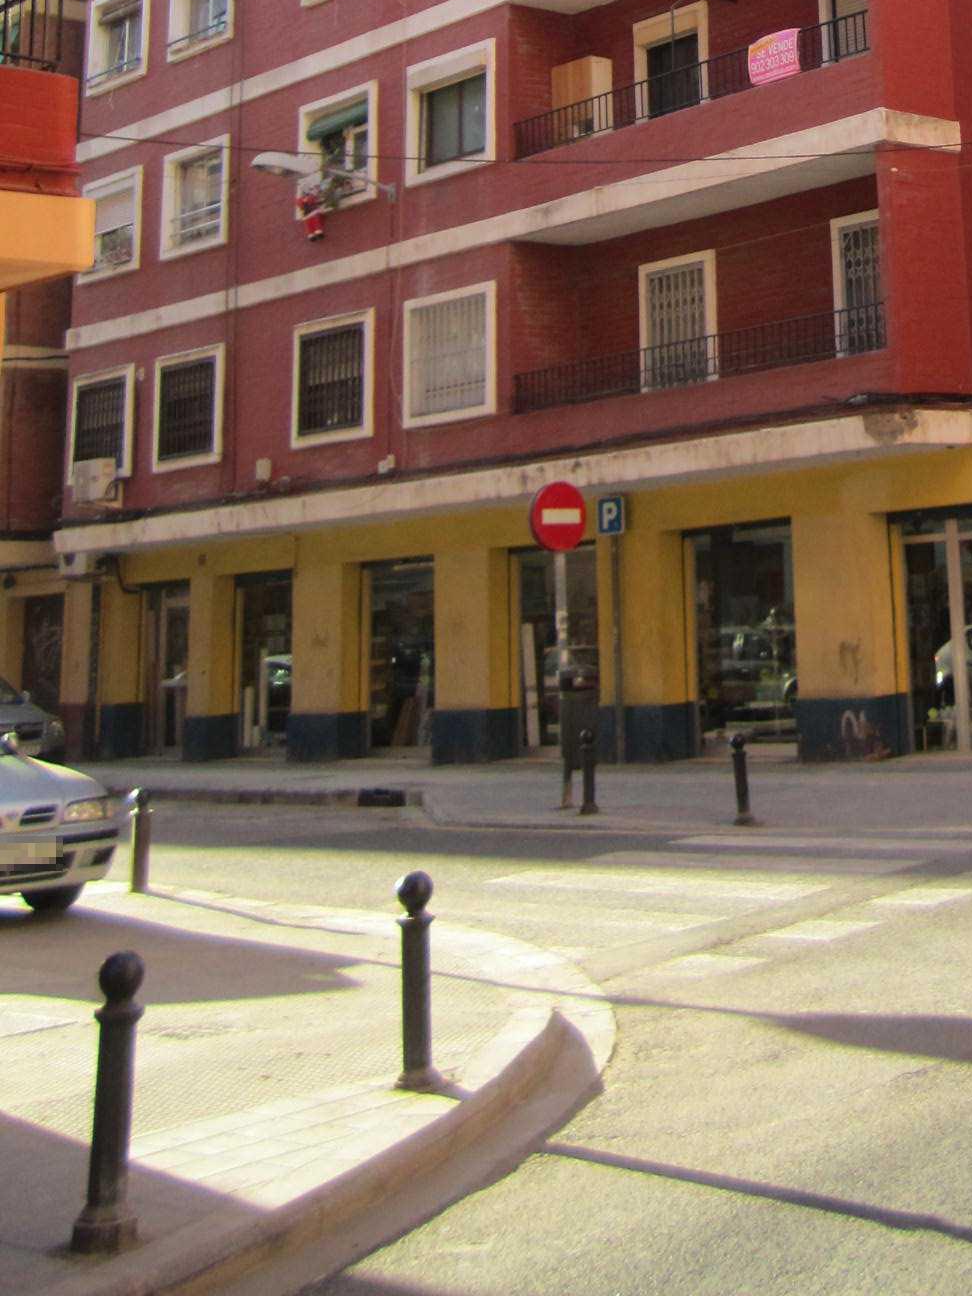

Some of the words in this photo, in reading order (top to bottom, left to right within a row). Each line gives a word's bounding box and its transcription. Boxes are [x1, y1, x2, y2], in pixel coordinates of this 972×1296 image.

[756, 48, 767, 59] SE
[768, 39, 794, 55] VENDE
[603, 502, 618, 529] P
